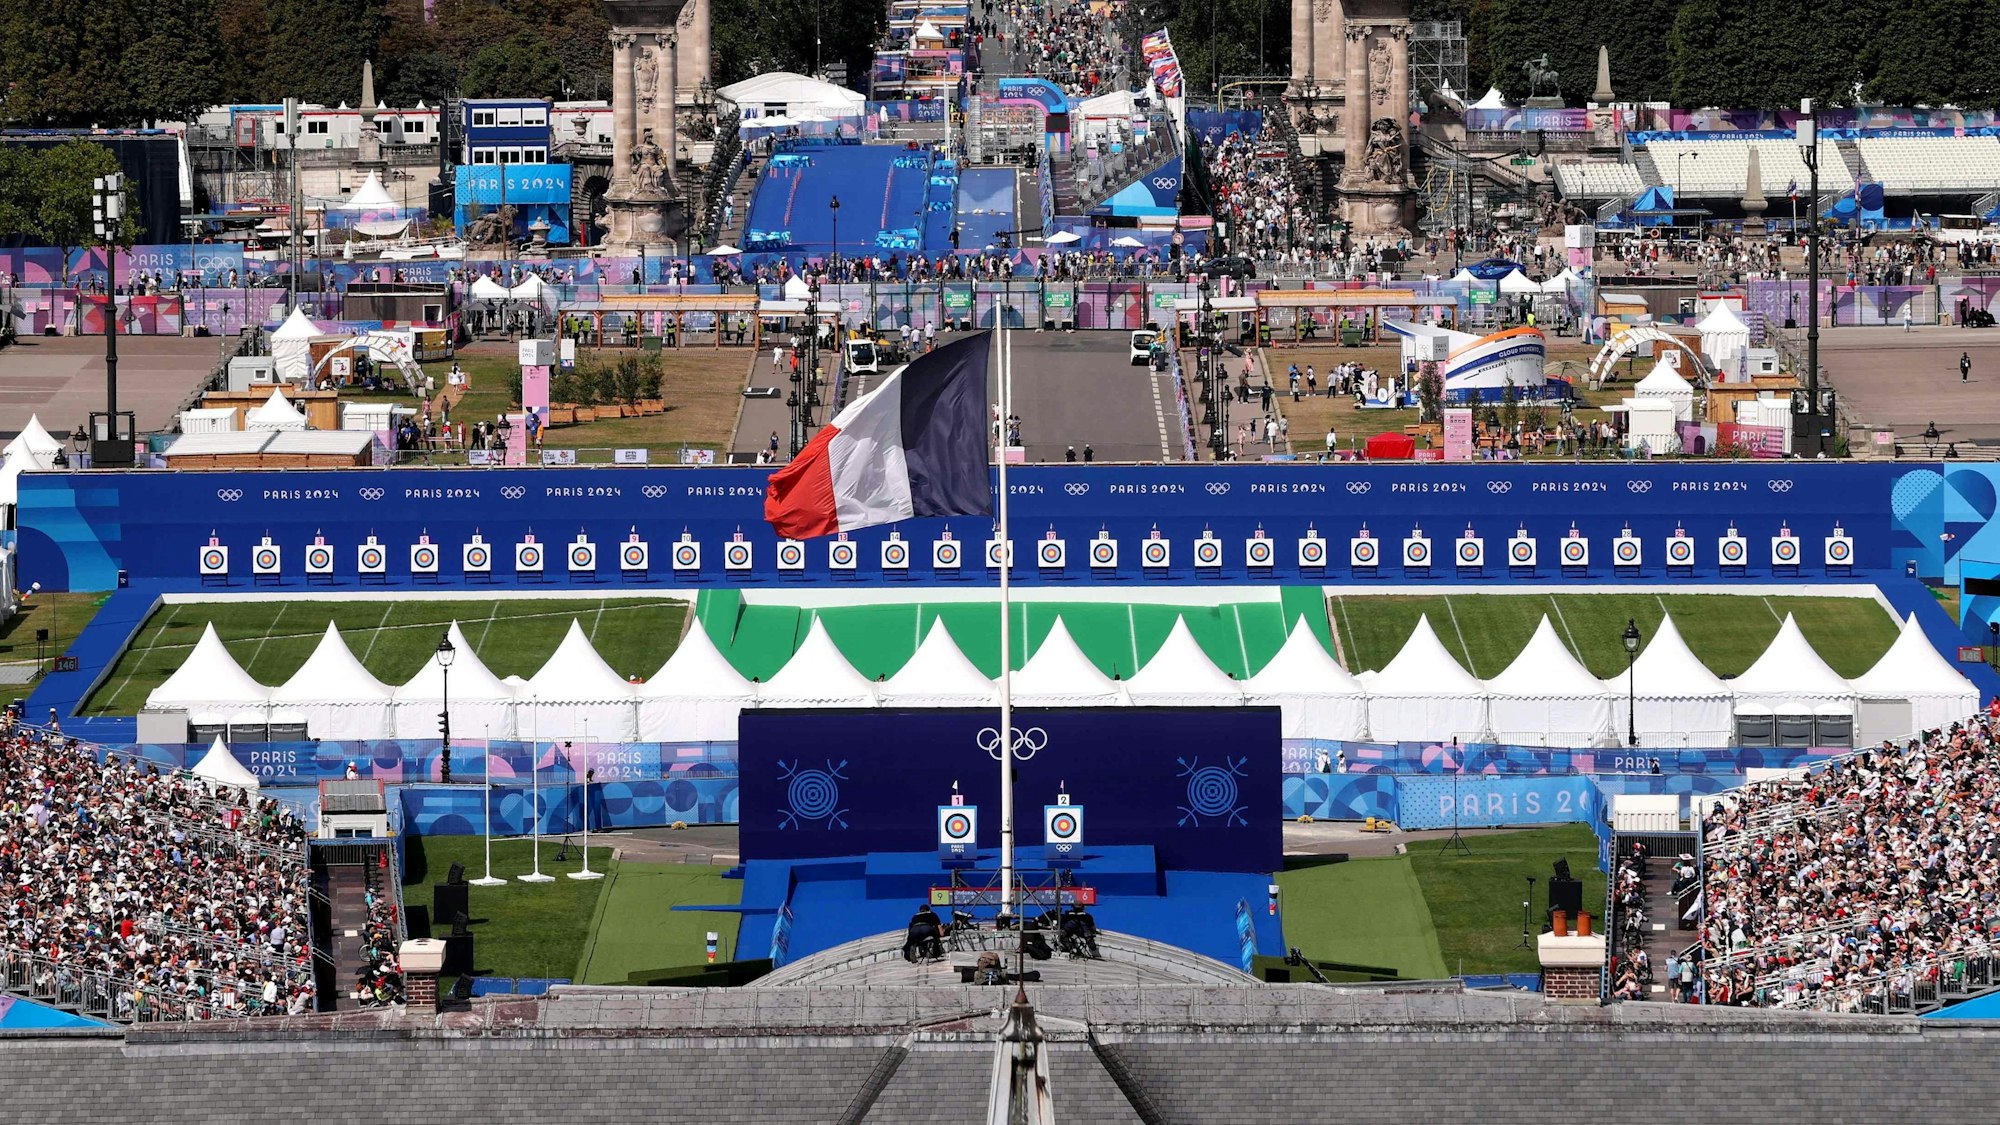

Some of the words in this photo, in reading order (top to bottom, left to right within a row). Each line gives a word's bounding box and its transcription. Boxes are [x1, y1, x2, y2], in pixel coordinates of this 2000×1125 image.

[468, 178, 515, 190] PARS
[521, 178, 565, 190] 2024
[1010, 485, 1045, 494] 2024
[1152, 485, 1185, 494] 2024
[1293, 484, 1326, 493] 2024
[1434, 483, 1466, 492] 2024
[1574, 482, 1606, 491] 2024
[1714, 482, 1747, 491] 2024
[306, 490, 339, 499] 2024
[447, 489, 480, 498] 2024
[588, 487, 620, 497] 2024
[729, 487, 762, 496] 2024
[839, 533, 847, 541] 13
[1100, 532, 1108, 540] 18
[1518, 530, 1527, 538] 26
[1570, 530, 1578, 538] 27
[1728, 529, 1737, 537] 30
[1782, 529, 1790, 537] 31
[58, 660, 75, 671] 146
[251, 765, 297, 777] 2024
[597, 766, 642, 778] 2024
[955, 796, 960, 805] 1
[1061, 796, 1067, 805] 2
[937, 892, 944, 901] 9
[1082, 892, 1088, 901] 6
